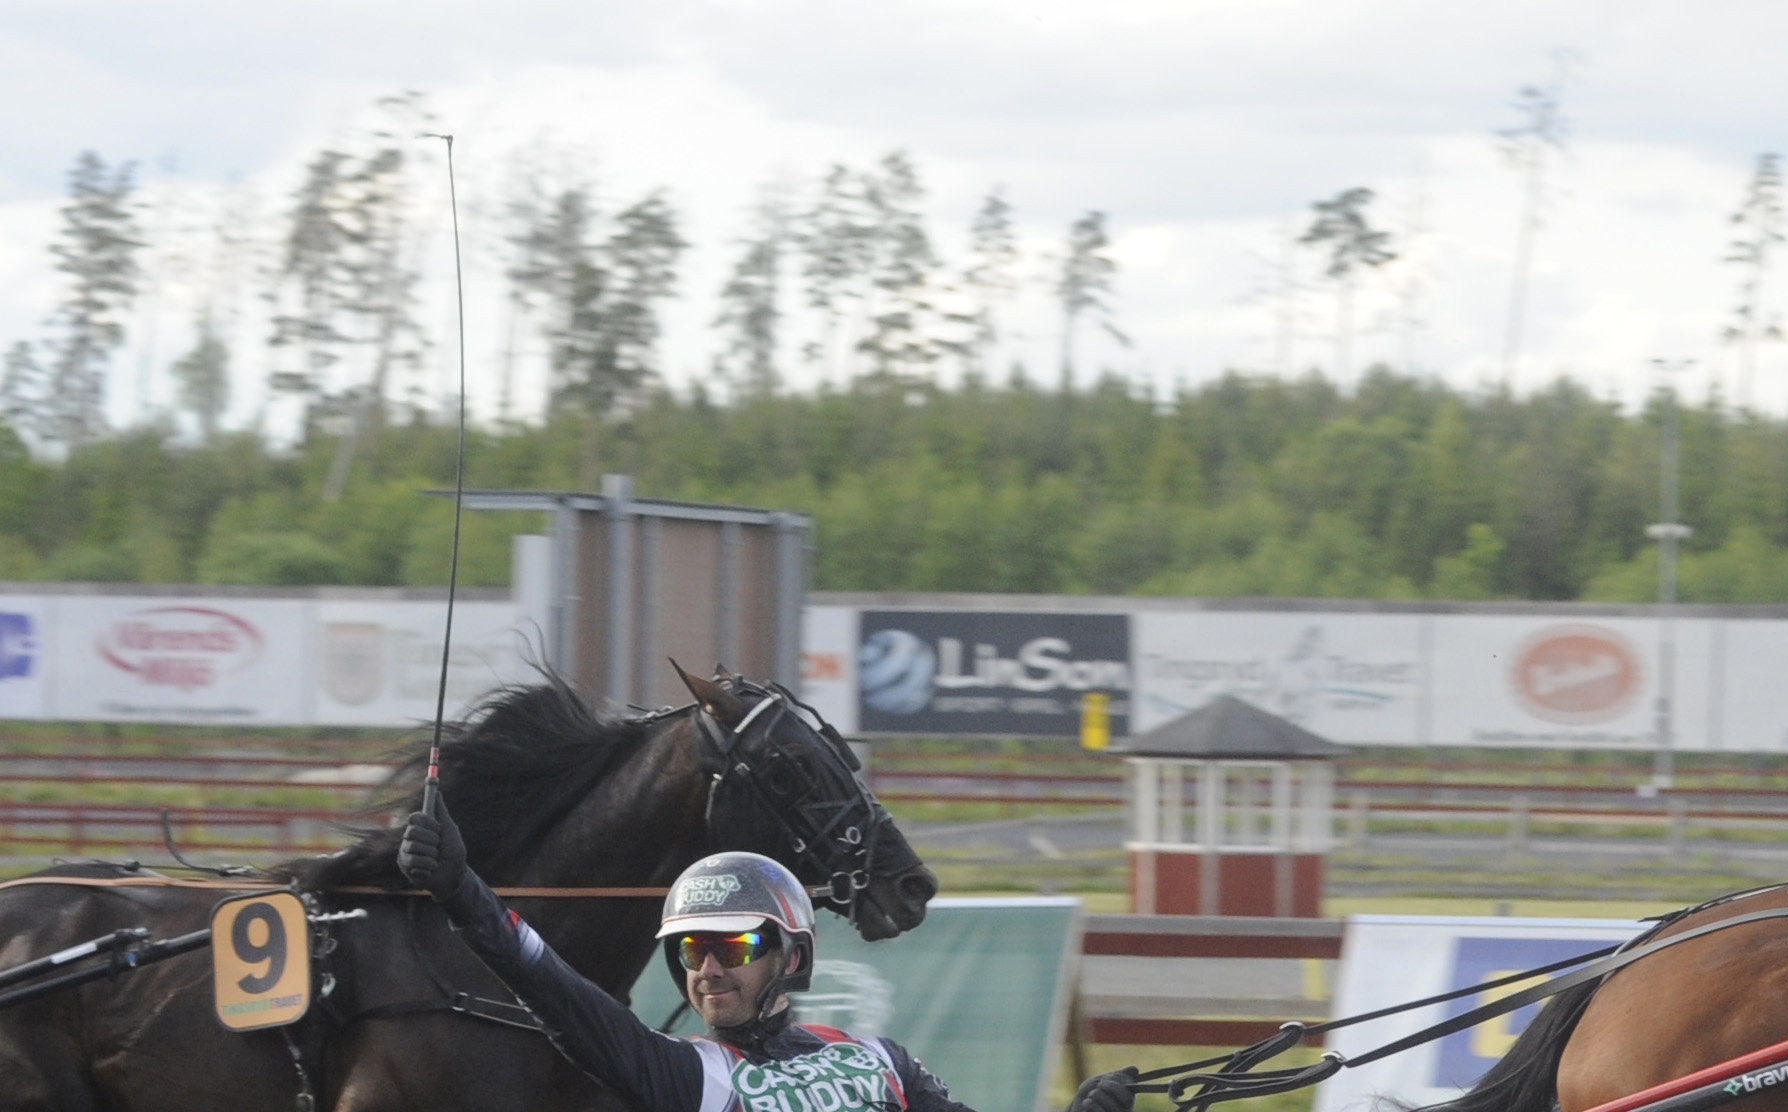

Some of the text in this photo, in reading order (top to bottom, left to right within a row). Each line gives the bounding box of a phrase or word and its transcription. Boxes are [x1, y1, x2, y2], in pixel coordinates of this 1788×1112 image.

[679, 889, 726, 902] UDDY
[231, 902, 287, 994] 9
[738, 1056, 847, 1096] CASH
